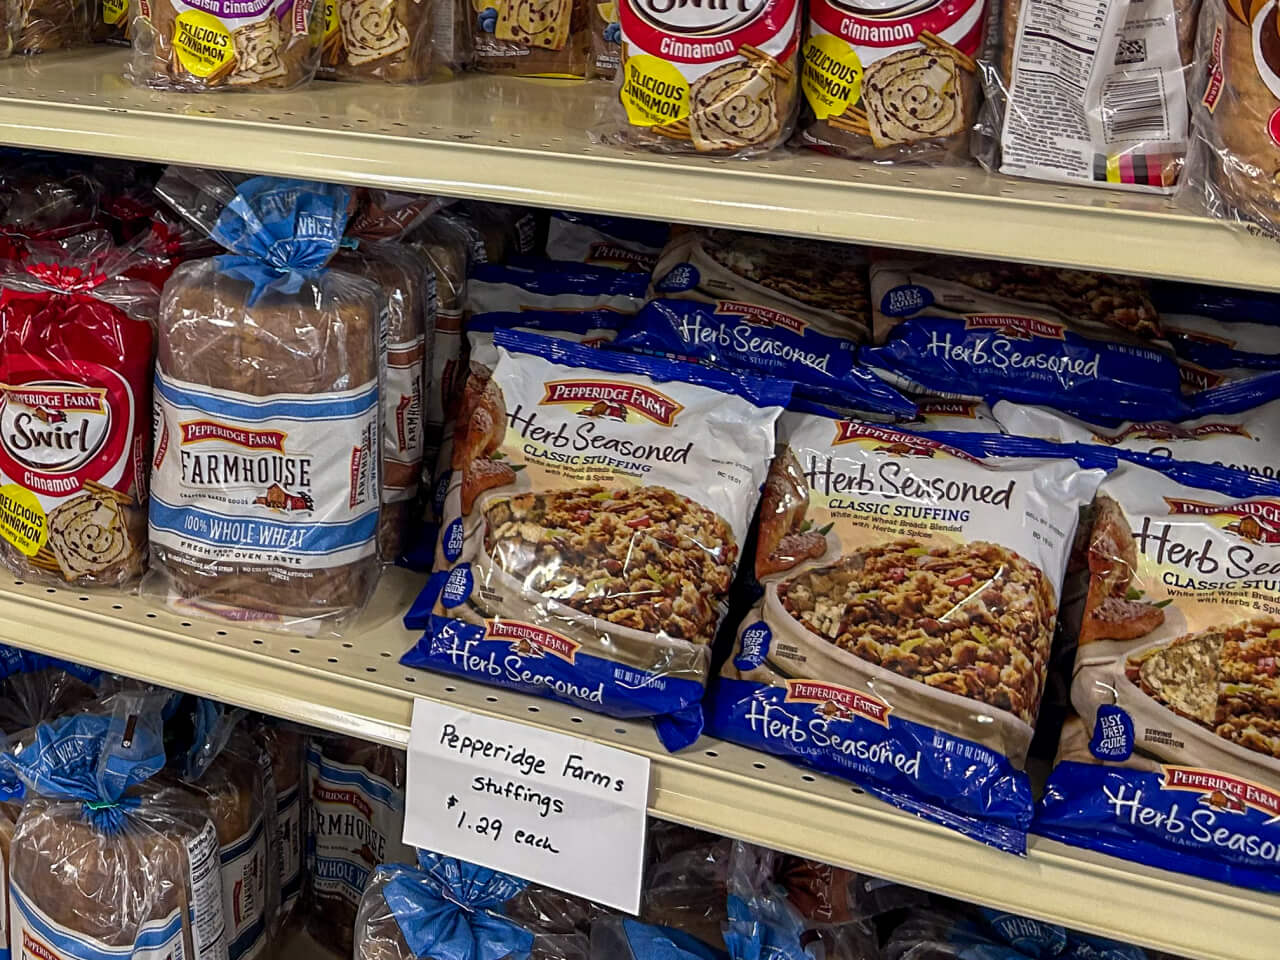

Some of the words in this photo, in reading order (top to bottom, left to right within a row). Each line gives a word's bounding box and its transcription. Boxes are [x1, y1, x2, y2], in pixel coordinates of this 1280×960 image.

[840, 18, 915, 42] Cinnamon
[660, 38, 734, 60] Cinnamon
[731, 325, 830, 371] Seasoned
[928, 331, 988, 364] Herb
[992, 339, 1101, 379] Seasoned
[63, 393, 97, 407] FARM
[553, 385, 629, 401] PEPPERIDGE
[629, 390, 667, 419] FARM
[12, 412, 90, 452] Swirl
[187, 424, 247, 442] PEPPERIDGE
[248, 430, 278, 446] FARM
[505, 405, 570, 448] Herb
[573, 422, 694, 464] Seasoned
[181, 451, 311, 488] FARMHOUSE
[523, 443, 580, 465] CLASSIC
[582, 454, 653, 473] STUFFING
[24, 472, 80, 491] Cinnamon
[803, 455, 873, 497] Herb
[879, 461, 1016, 510] Seasoned
[828, 498, 890, 515] CLASSIC
[893, 504, 970, 522] STUFFING
[184, 514, 208, 533] 100%
[209, 520, 254, 542] WHOLE
[258, 525, 306, 547] WHEAT
[1132, 516, 1218, 574] Herb
[1163, 572, 1235, 590] CLASSIC
[492, 622, 546, 643] PEPPERIDGE
[544, 633, 570, 654] FARM
[446, 638, 502, 677] Herb
[504, 659, 605, 705] Seasoned
[793, 683, 853, 704] PEPPERIDGE
[853, 697, 882, 717] FARM
[745, 699, 808, 743] Herb
[809, 720, 921, 777] Seasoned
[1100, 735, 1126, 748] GUIDE
[1103, 725, 1124, 739] PREP
[439, 724, 546, 776] Pepperidge
[562, 755, 624, 792] Farms
[1173, 771, 1245, 801] PEPPERIDGE
[1245, 784, 1278, 812] FARM
[1104, 784, 1184, 834] Herb
[514, 829, 560, 854] each
